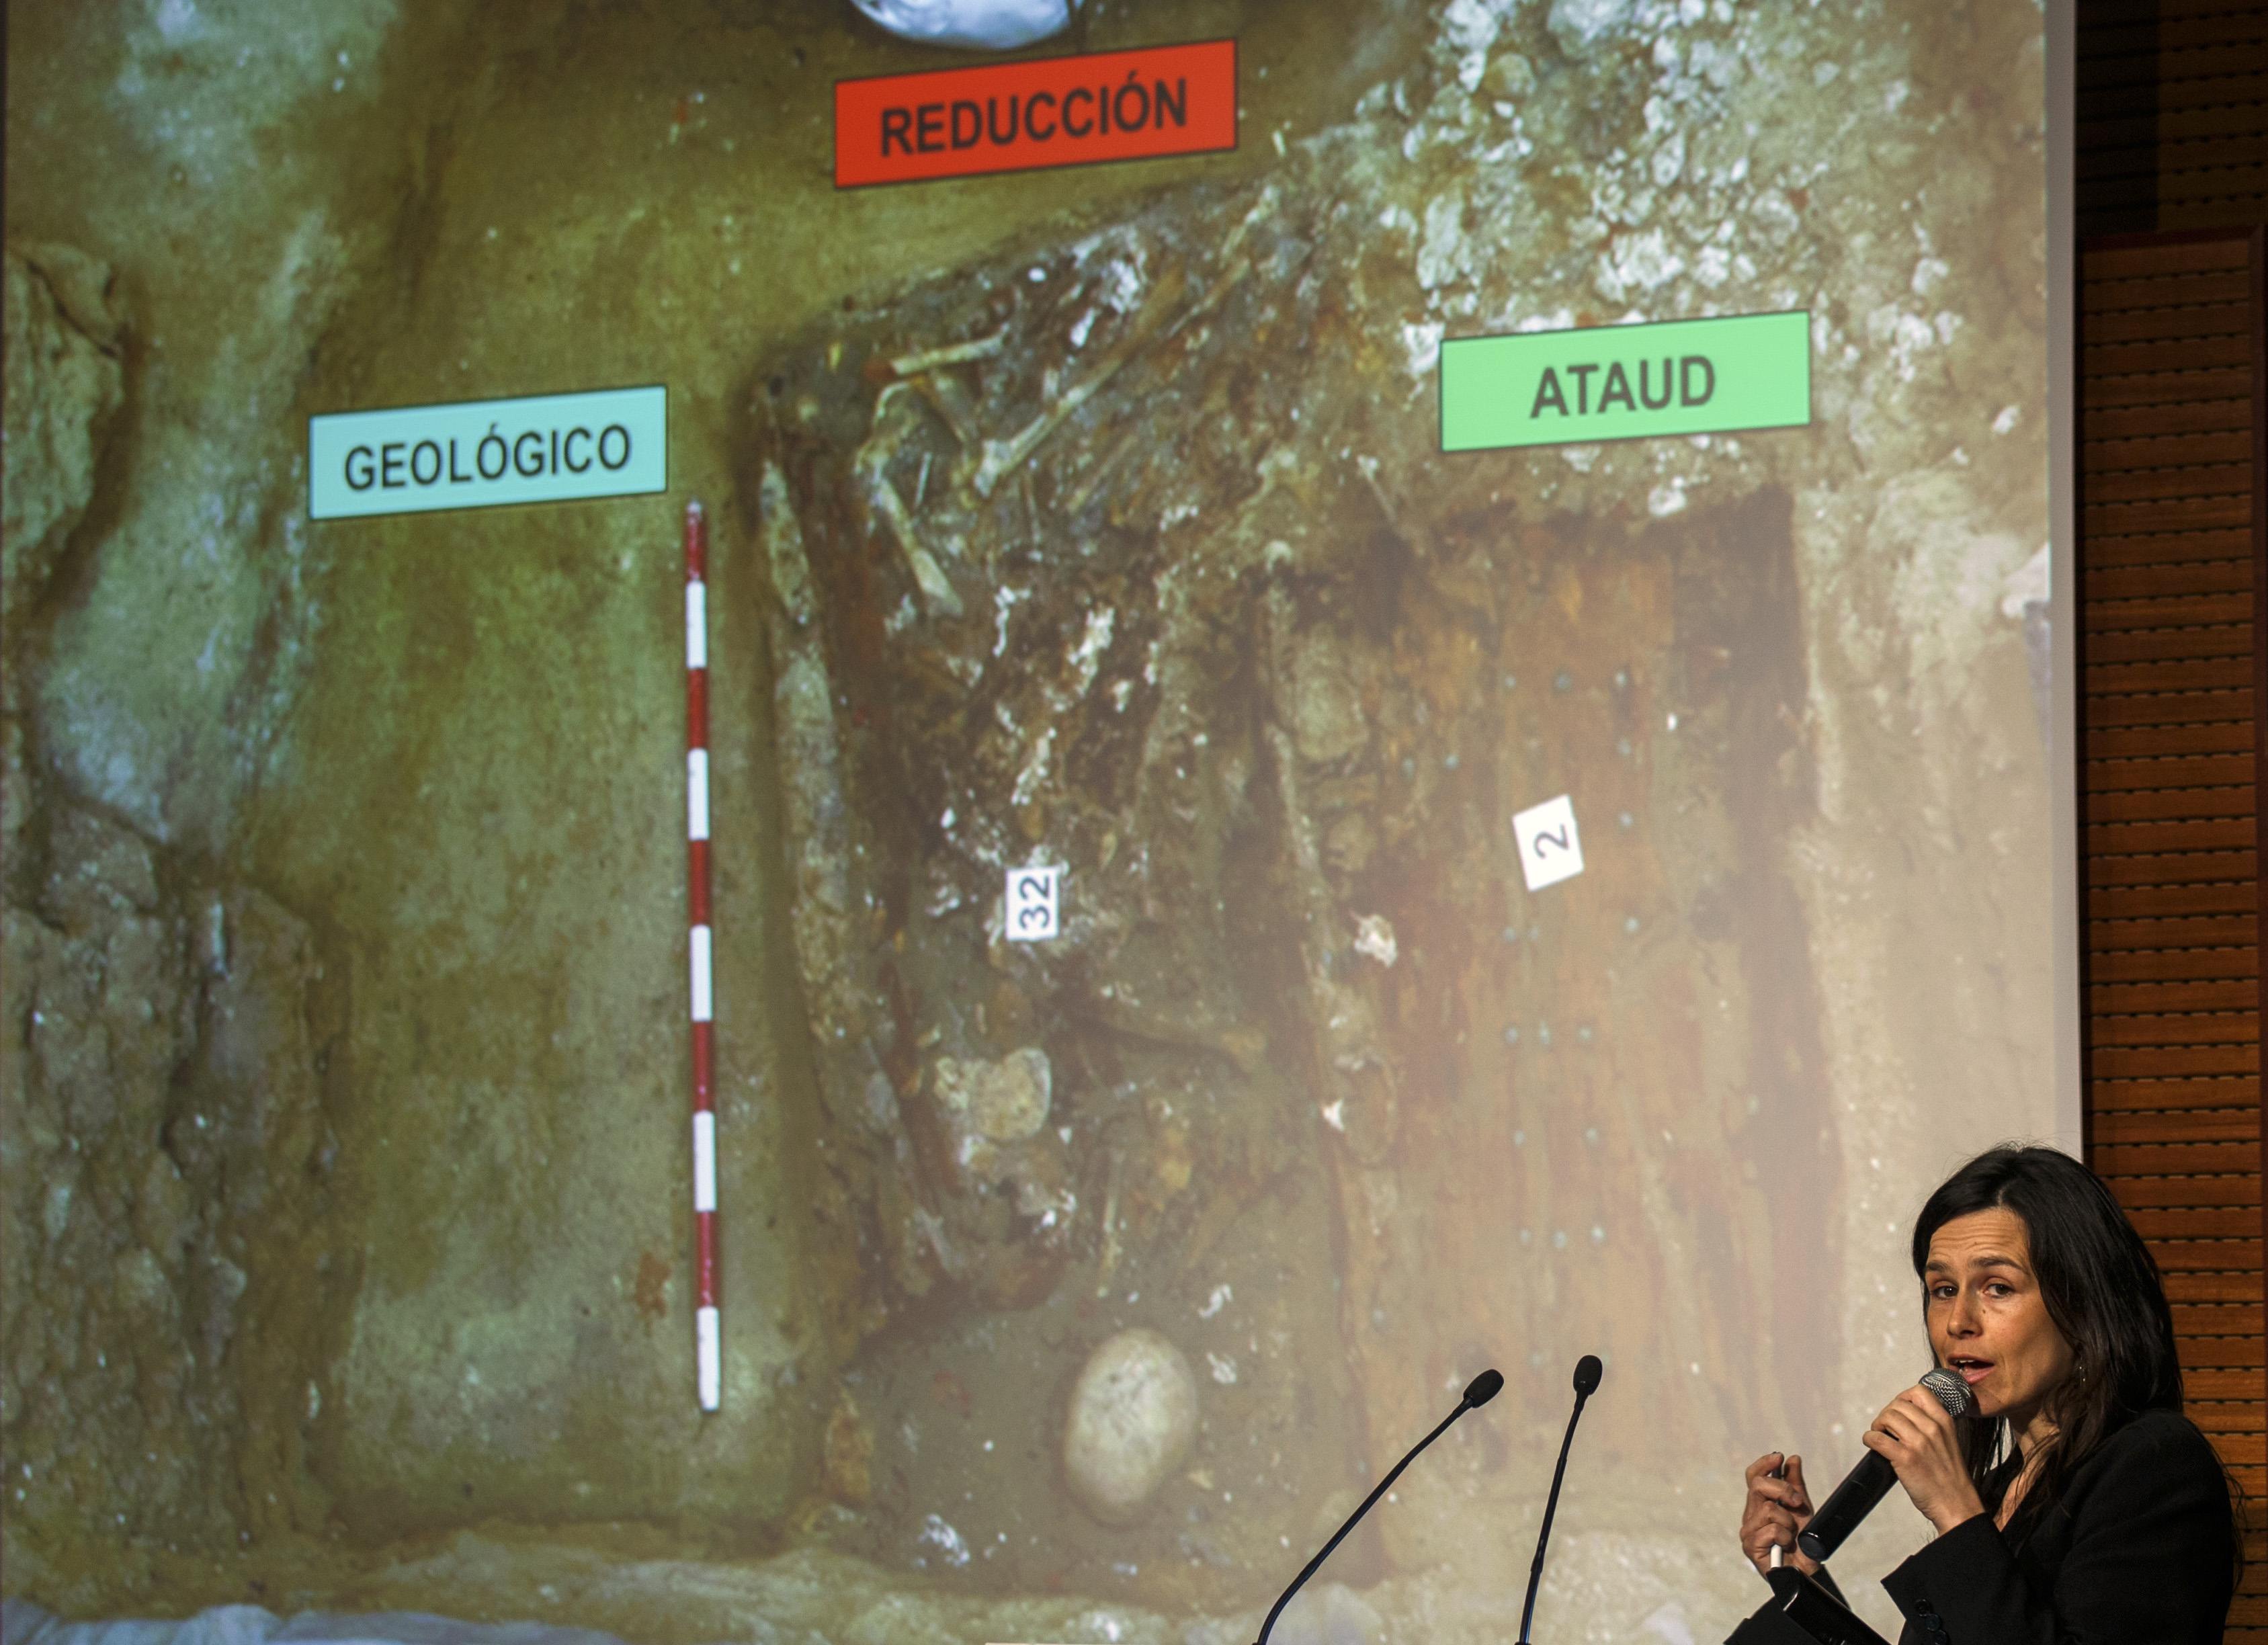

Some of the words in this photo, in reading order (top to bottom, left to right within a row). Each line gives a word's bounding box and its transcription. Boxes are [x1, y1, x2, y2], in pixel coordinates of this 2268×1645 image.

[880, 70, 1186, 157] REDUCCIÓN
[1530, 355, 1716, 419] ATAUD
[344, 422, 631, 491] GEOLÓGICO
[1534, 823, 1570, 859] 2
[1019, 874, 1050, 930] 32
